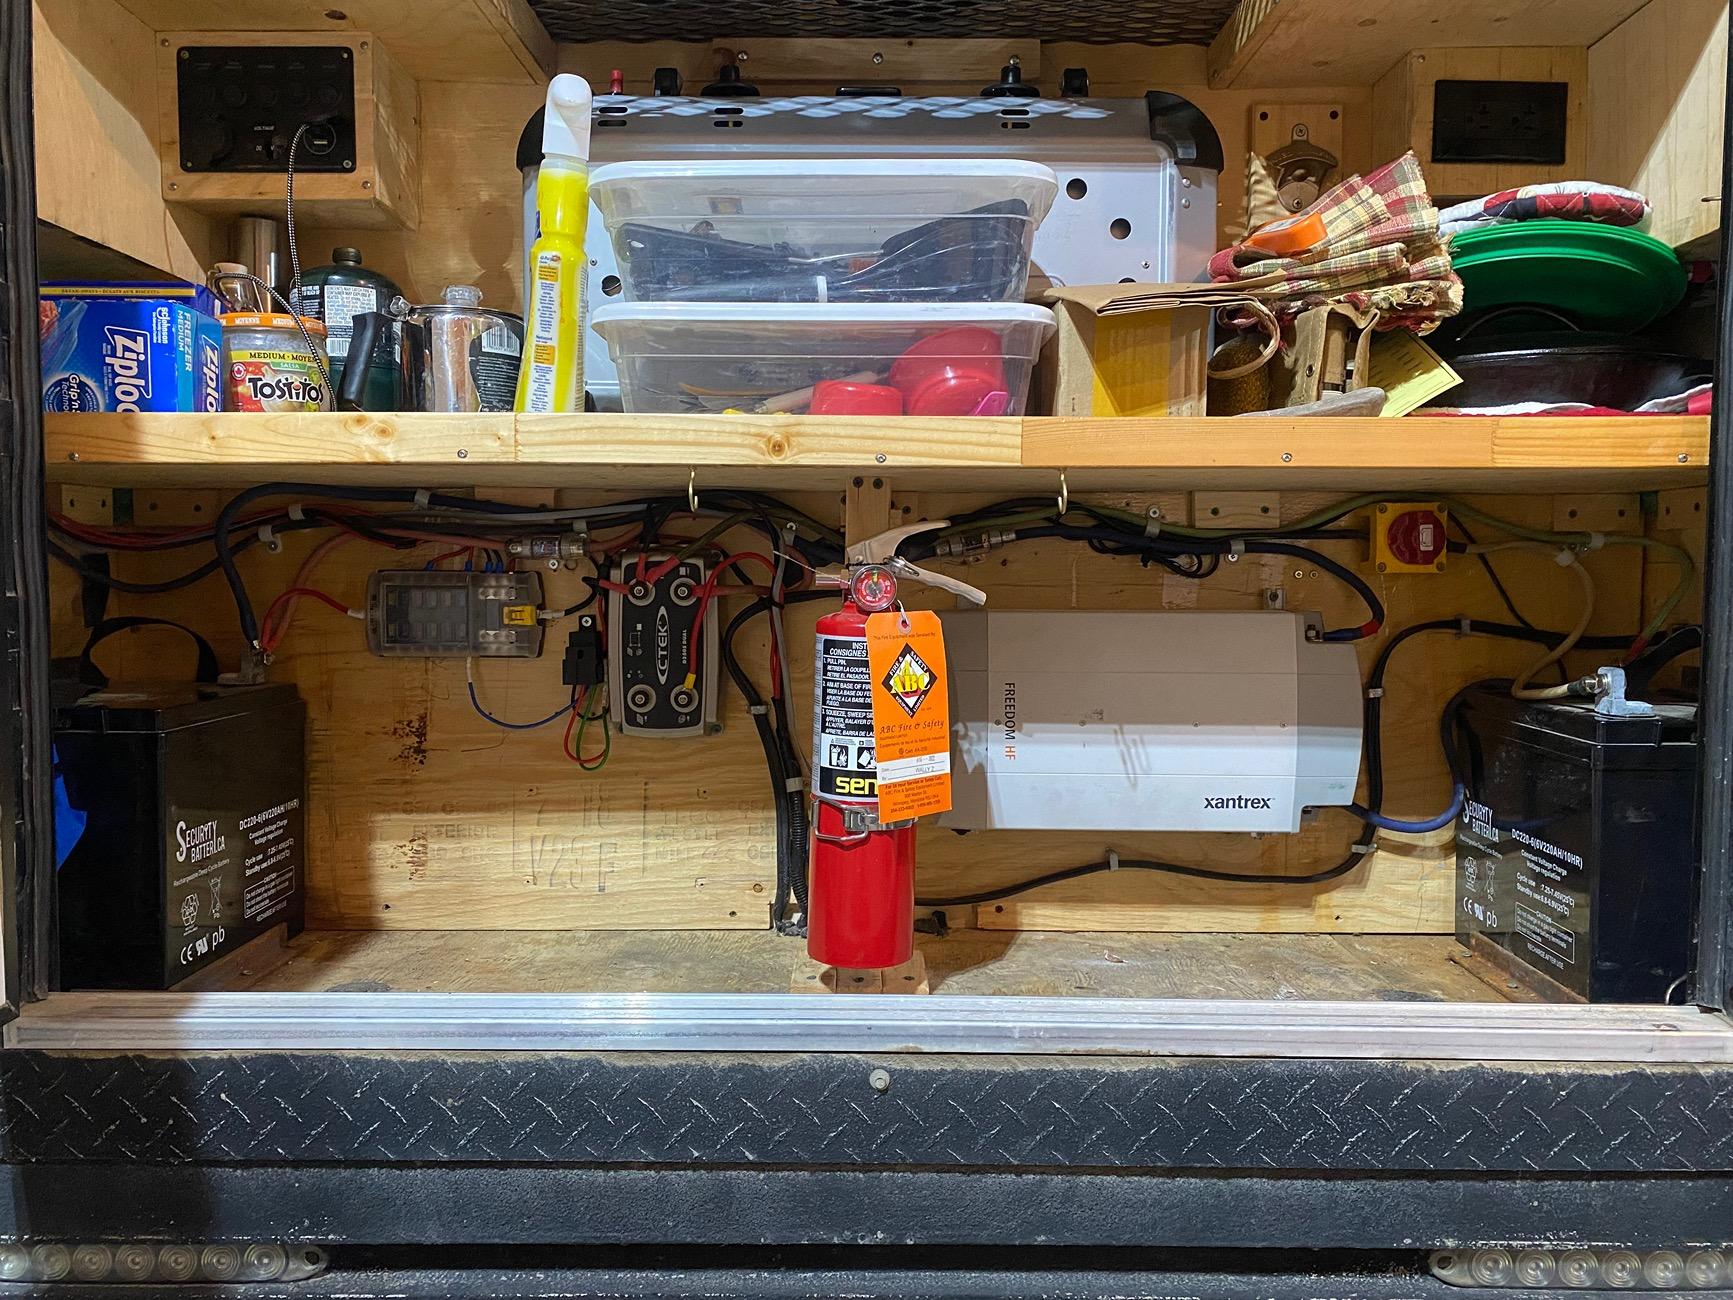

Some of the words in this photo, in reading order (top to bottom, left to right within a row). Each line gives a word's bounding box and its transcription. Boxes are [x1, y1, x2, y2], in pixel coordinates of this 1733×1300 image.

[184, 312, 192, 372] FREEZER
[658, 626, 668, 670] CTEK
[830, 648, 867, 657] CONSIGNES
[889, 661, 900, 676] FIRE
[910, 651, 928, 671] SAFETY
[890, 672, 930, 693] ABC
[1004, 682, 1015, 740] FREEDOM
[880, 724, 895, 734] ABC
[899, 724, 912, 732] Fire
[923, 720, 944, 730] Safety
[1005, 746, 1015, 760] HF
[836, 776, 878, 795] sen
[1204, 795, 1272, 809] xantrex
[176, 820, 218, 862] SECURITY
[1512, 828, 1583, 870] DC220-6(6V220AH/10HR)
[245, 856, 255, 866] Cycle
[1516, 872, 1527, 882] Cycle
[1487, 911, 1497, 928] pb
[212, 925, 225, 950] pb
